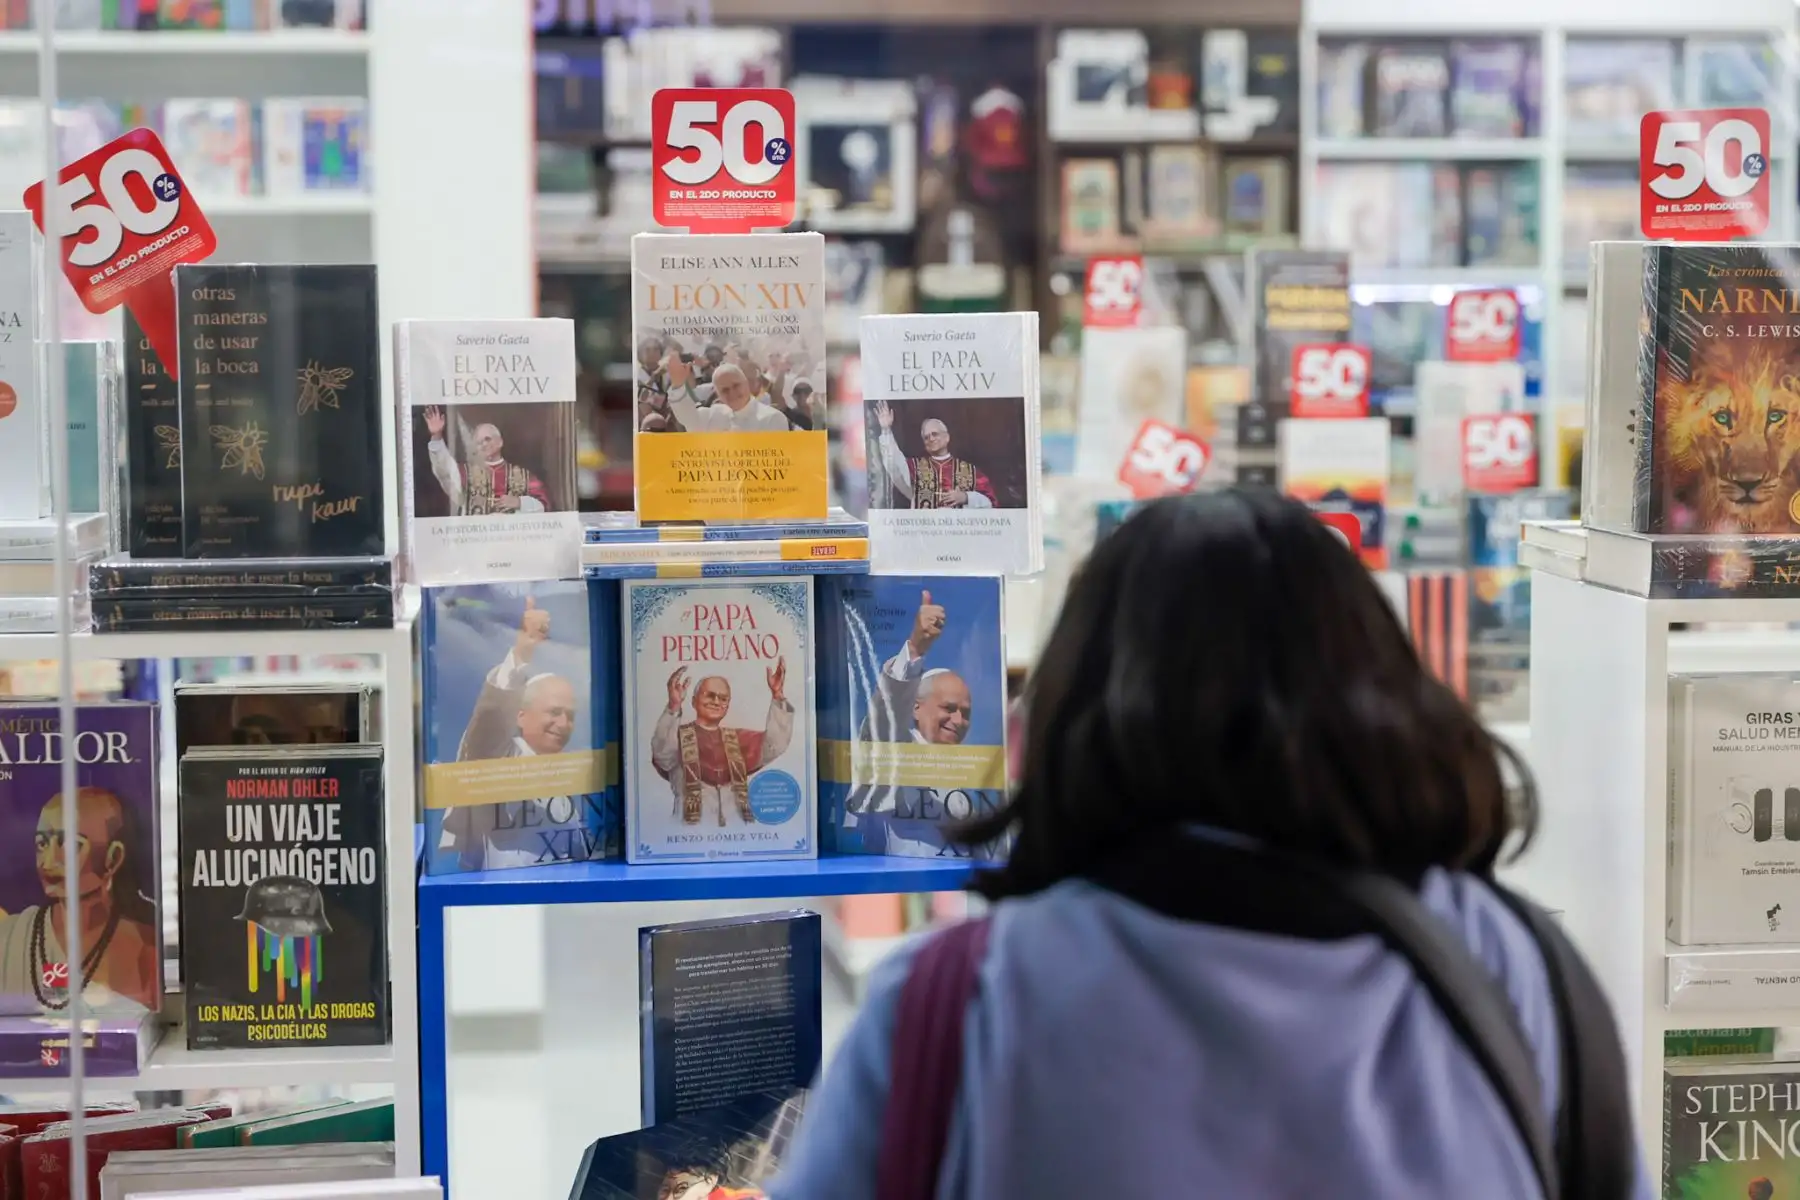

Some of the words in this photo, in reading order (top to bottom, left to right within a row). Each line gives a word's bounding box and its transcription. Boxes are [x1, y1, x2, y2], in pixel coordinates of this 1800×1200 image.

[661, 100, 784, 184] 50
[771, 142, 786, 155] %
[1648, 119, 1761, 198] 50
[670, 190, 683, 199] EN
[686, 190, 698, 199] EL
[699, 190, 720, 199] 2DO
[722, 190, 776, 199] PRODUCTO
[56, 149, 180, 266] 50
[1683, 204, 1701, 212] 2DO
[1704, 202, 1753, 211] PRODUCTO
[89, 271, 104, 285] EN
[104, 265, 119, 280] EL
[116, 254, 138, 272] 2DO
[138, 225, 190, 259] PRODUCTO
[661, 257, 705, 269] ELISE
[709, 256, 743, 268] ANN
[750, 256, 799, 268] ALLEN
[1707, 264, 1731, 277] Las
[1734, 264, 1787, 277] crónica
[192, 287, 235, 301] otras
[648, 277, 747, 311] LEÓN
[756, 283, 818, 310] XIV
[1089, 260, 1141, 310] 50
[193, 313, 268, 325] maneras
[663, 316, 729, 325] CIUDADANO
[1449, 296, 1519, 343] 50
[456, 335, 495, 345] Saverio
[498, 334, 529, 345] Gaeta
[662, 327, 723, 336] MISIONERO
[783, 326, 800, 335] XXI
[903, 331, 942, 342] Saverio
[945, 330, 976, 341] Gaeta
[1702, 325, 1719, 337] C.
[1726, 325, 1740, 337] S.
[1747, 325, 1800, 337] LEWIS
[194, 335, 215, 350] de
[221, 338, 258, 350] usar
[141, 358, 156, 374] la
[195, 358, 211, 374] la
[217, 357, 259, 374] boca
[454, 355, 475, 373] EL
[486, 354, 536, 373] PAPA
[902, 352, 922, 370] EL
[932, 350, 982, 369] PAPA
[889, 370, 945, 392] LEÓN
[955, 373, 996, 391] XIV
[1295, 348, 1365, 399] 50
[508, 377, 550, 395] XIV
[680, 450, 722, 458] INCLUYE
[740, 449, 785, 458] PRIMERA
[1465, 419, 1535, 470] 50
[1130, 424, 1203, 487] 50
[678, 470, 714, 482] PAPA
[761, 468, 787, 480] XIV
[273, 482, 324, 510] rupi
[312, 497, 363, 523] kaur
[694, 605, 757, 631] PAPA
[662, 633, 779, 662] PERUANO
[1746, 712, 1793, 724] GIRAS
[1719, 728, 1769, 740] SALUD
[227, 778, 288, 799] NORMAN
[293, 778, 339, 798] OHLER
[226, 805, 263, 842] UN
[269, 804, 341, 841] VIAJE
[667, 835, 703, 843] RENZO
[707, 833, 745, 842] GÓMEZ
[750, 832, 779, 841] VEGA
[192, 842, 376, 887] ALUCINÓGENO
[199, 1006, 219, 1021] LOS
[222, 1005, 259, 1022] NAZIS,
[261, 1005, 275, 1020] LA
[277, 1004, 295, 1020] CIA
[298, 1005, 304, 1019] Y
[331, 1002, 375, 1019] DROGAS
[248, 1021, 326, 1041] PSICODÉLICAS
